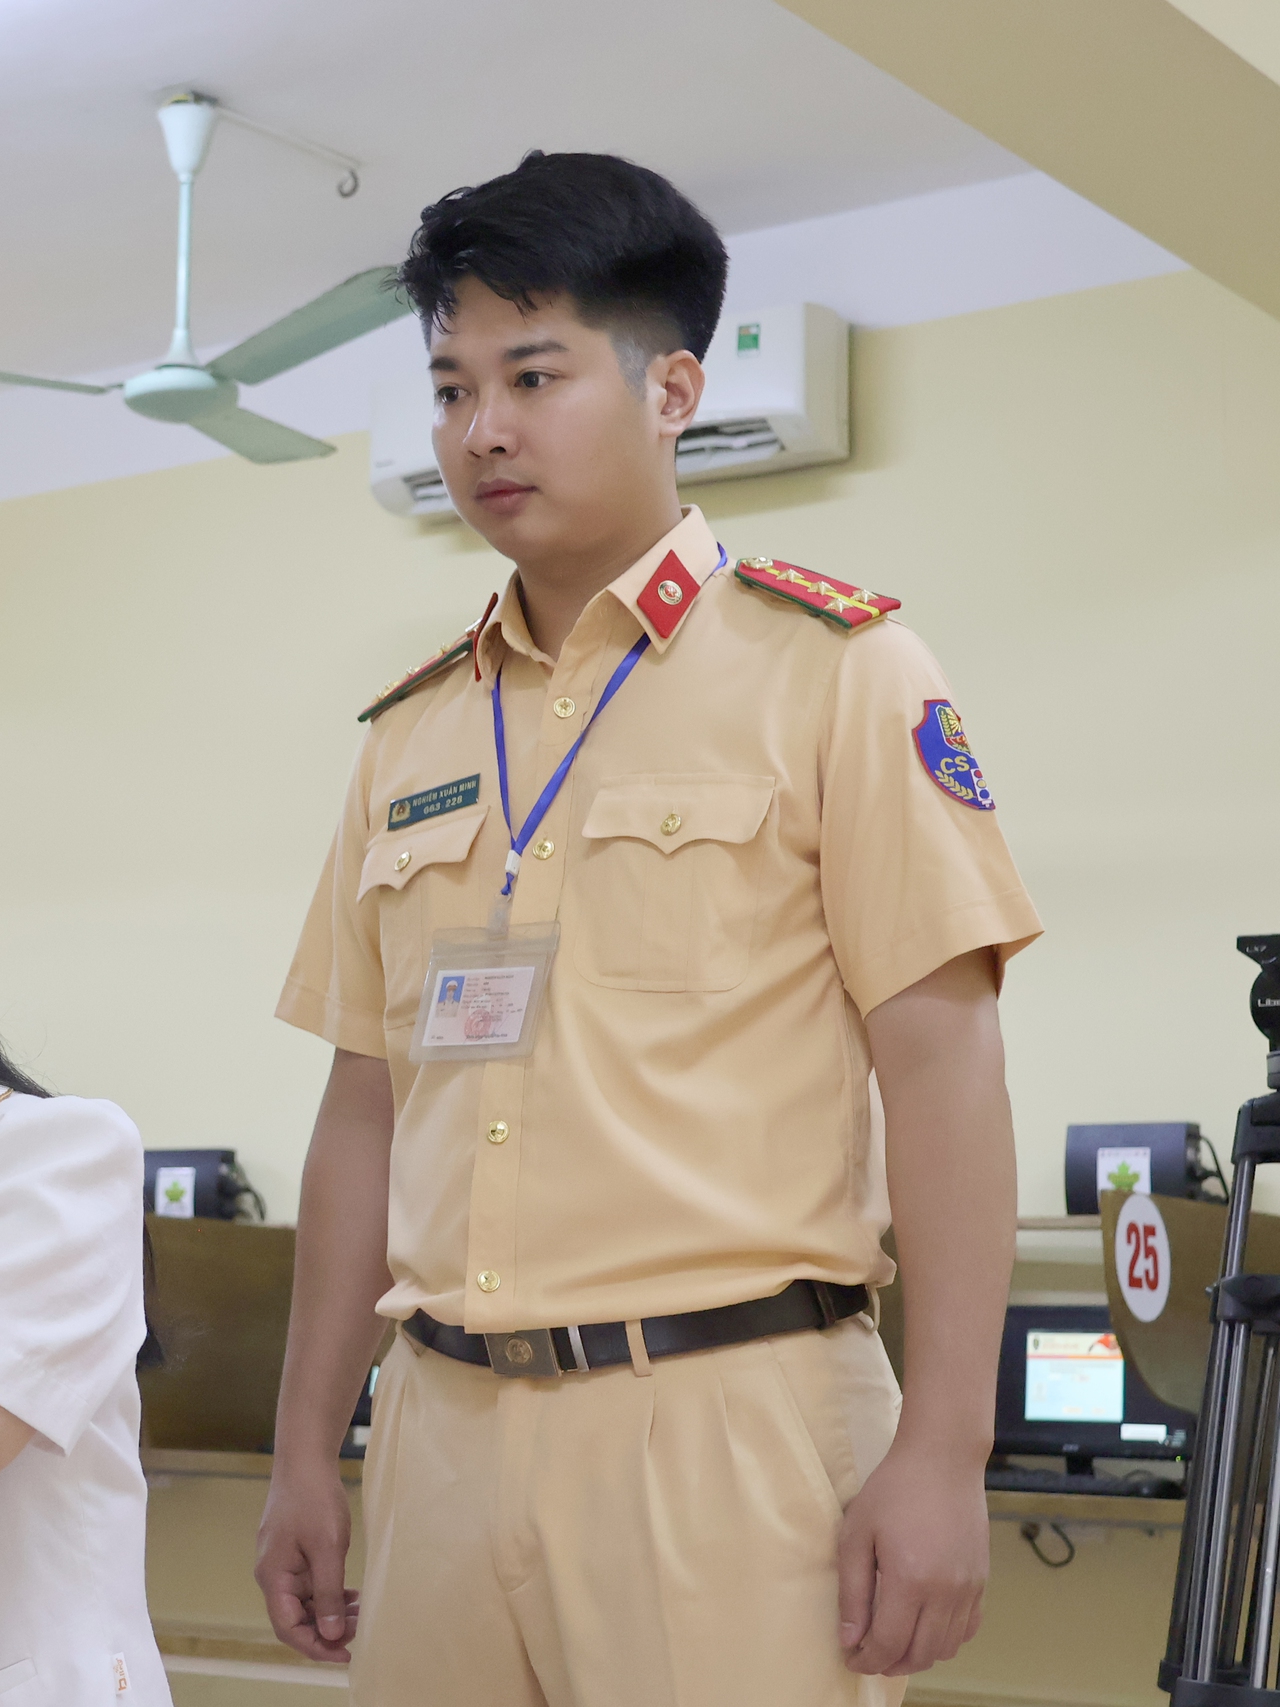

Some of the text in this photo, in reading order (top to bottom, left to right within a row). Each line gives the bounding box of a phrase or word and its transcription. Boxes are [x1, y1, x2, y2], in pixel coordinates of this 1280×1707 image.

[940, 756, 970, 774] CS
[439, 786, 458, 798] XUÂN
[459, 781, 477, 793] MINH
[1125, 1220, 1160, 1292] 25
